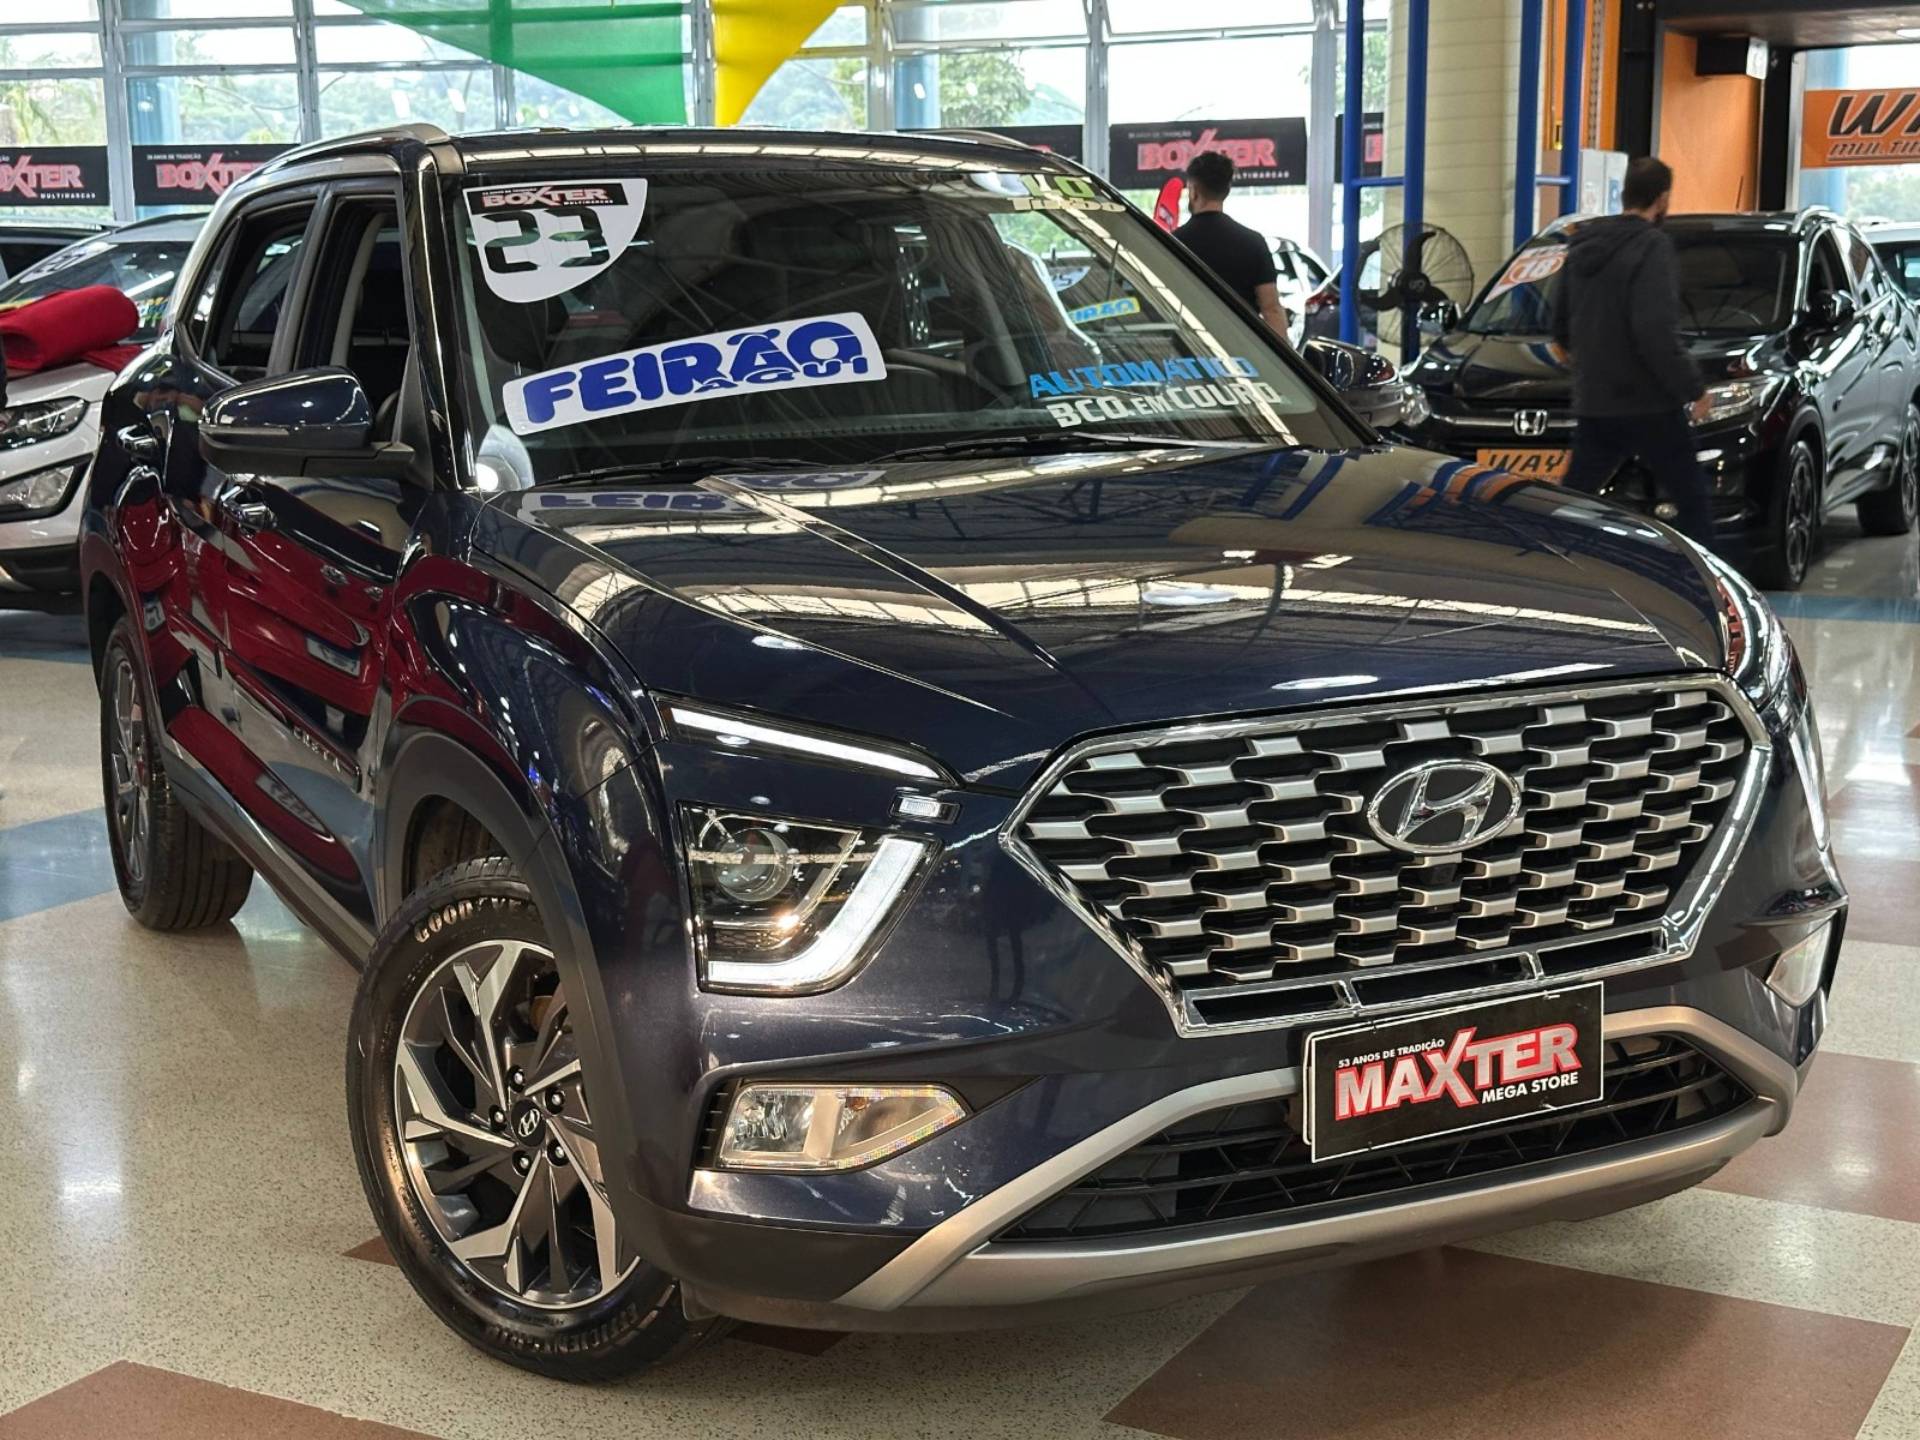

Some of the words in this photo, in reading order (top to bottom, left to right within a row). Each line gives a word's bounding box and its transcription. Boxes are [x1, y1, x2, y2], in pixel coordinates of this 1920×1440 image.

[482, 186, 609, 208] BOXTER
[481, 206, 610, 274] 23
[523, 321, 863, 424] FEIRÃO
[1134, 396, 1173, 416] EM
[1166, 382, 1282, 410] COURO
[1488, 453, 1567, 473] WAY
[1338, 1059, 1351, 1069] 53
[1352, 1052, 1381, 1066] ANOS
[1383, 1049, 1396, 1059] DE
[1397, 1038, 1446, 1055] TRADIÇÃO
[1335, 1023, 1582, 1121] MAXTER
[1481, 1085, 1528, 1104] MEGA
[1531, 1072, 1579, 1092] STORE
